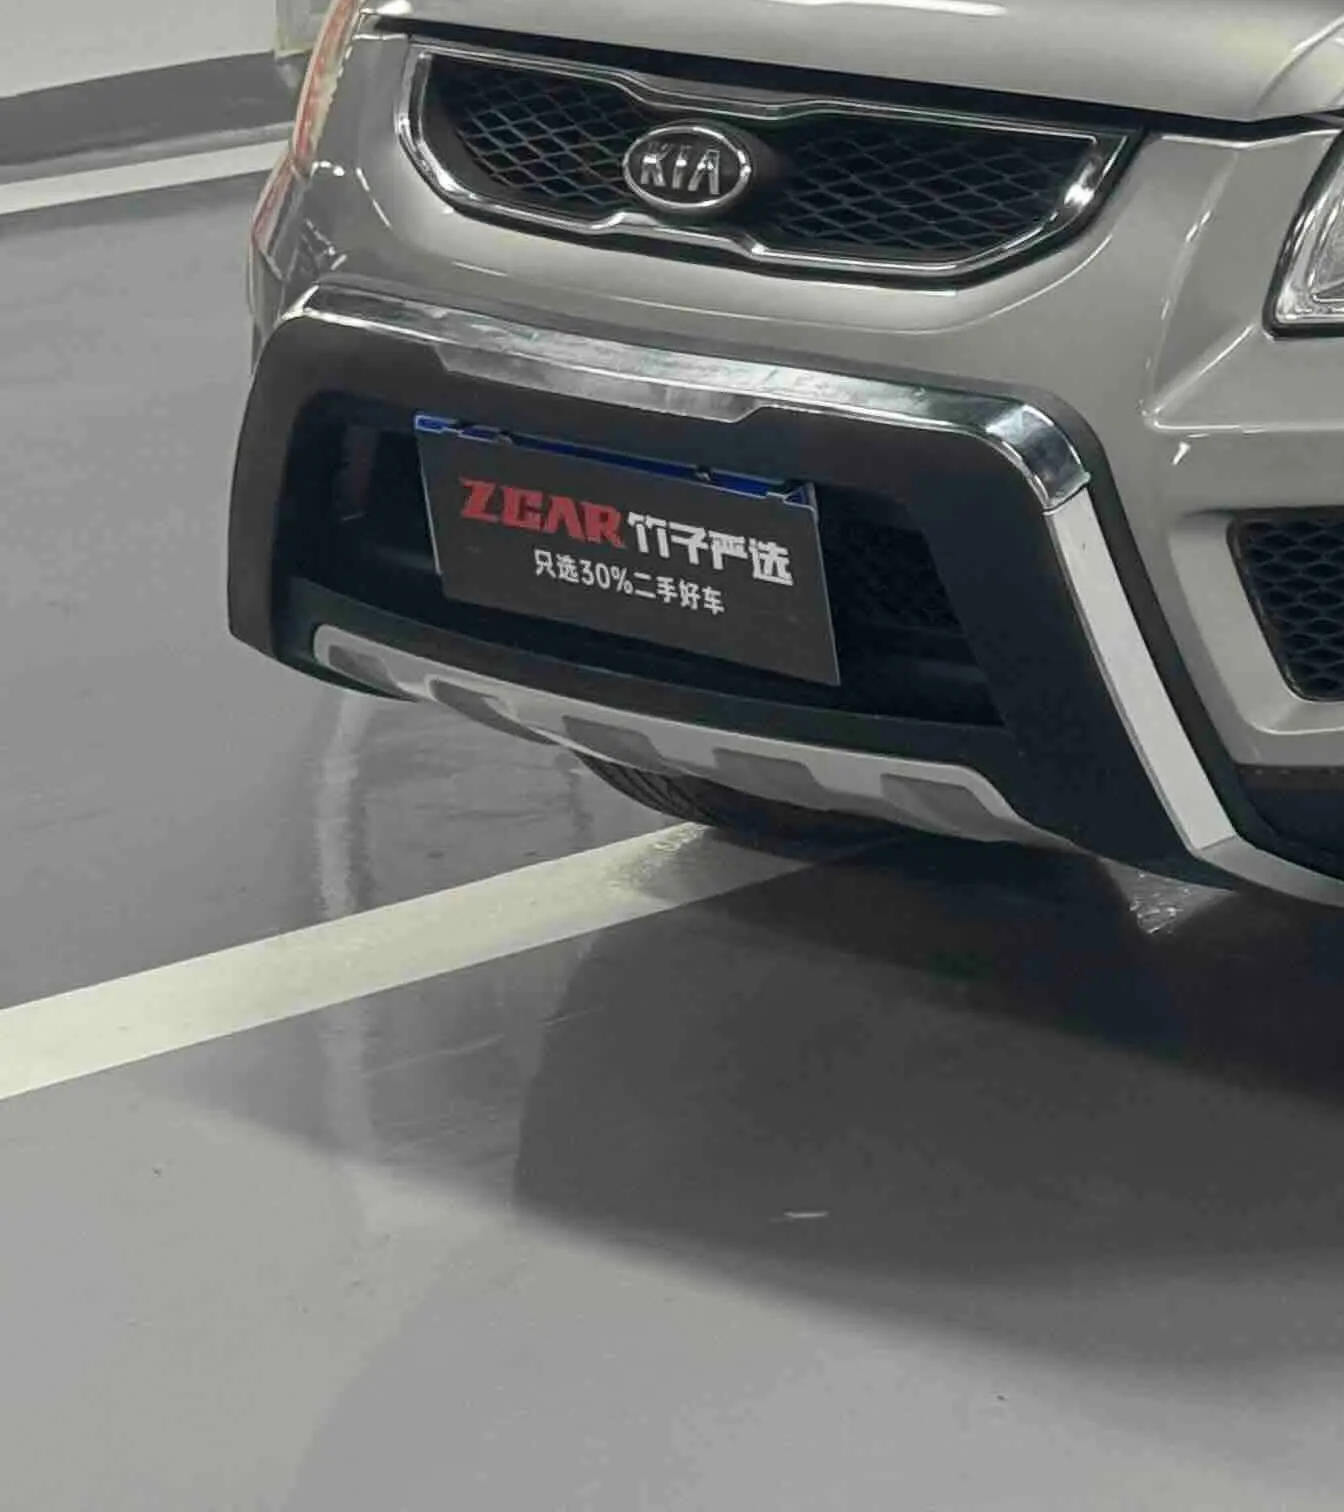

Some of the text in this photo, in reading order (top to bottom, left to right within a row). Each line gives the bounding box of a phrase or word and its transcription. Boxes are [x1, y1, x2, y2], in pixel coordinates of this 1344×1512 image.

[640, 140, 721, 195] KIA
[533, 547, 726, 615] 只选30%二手好车
